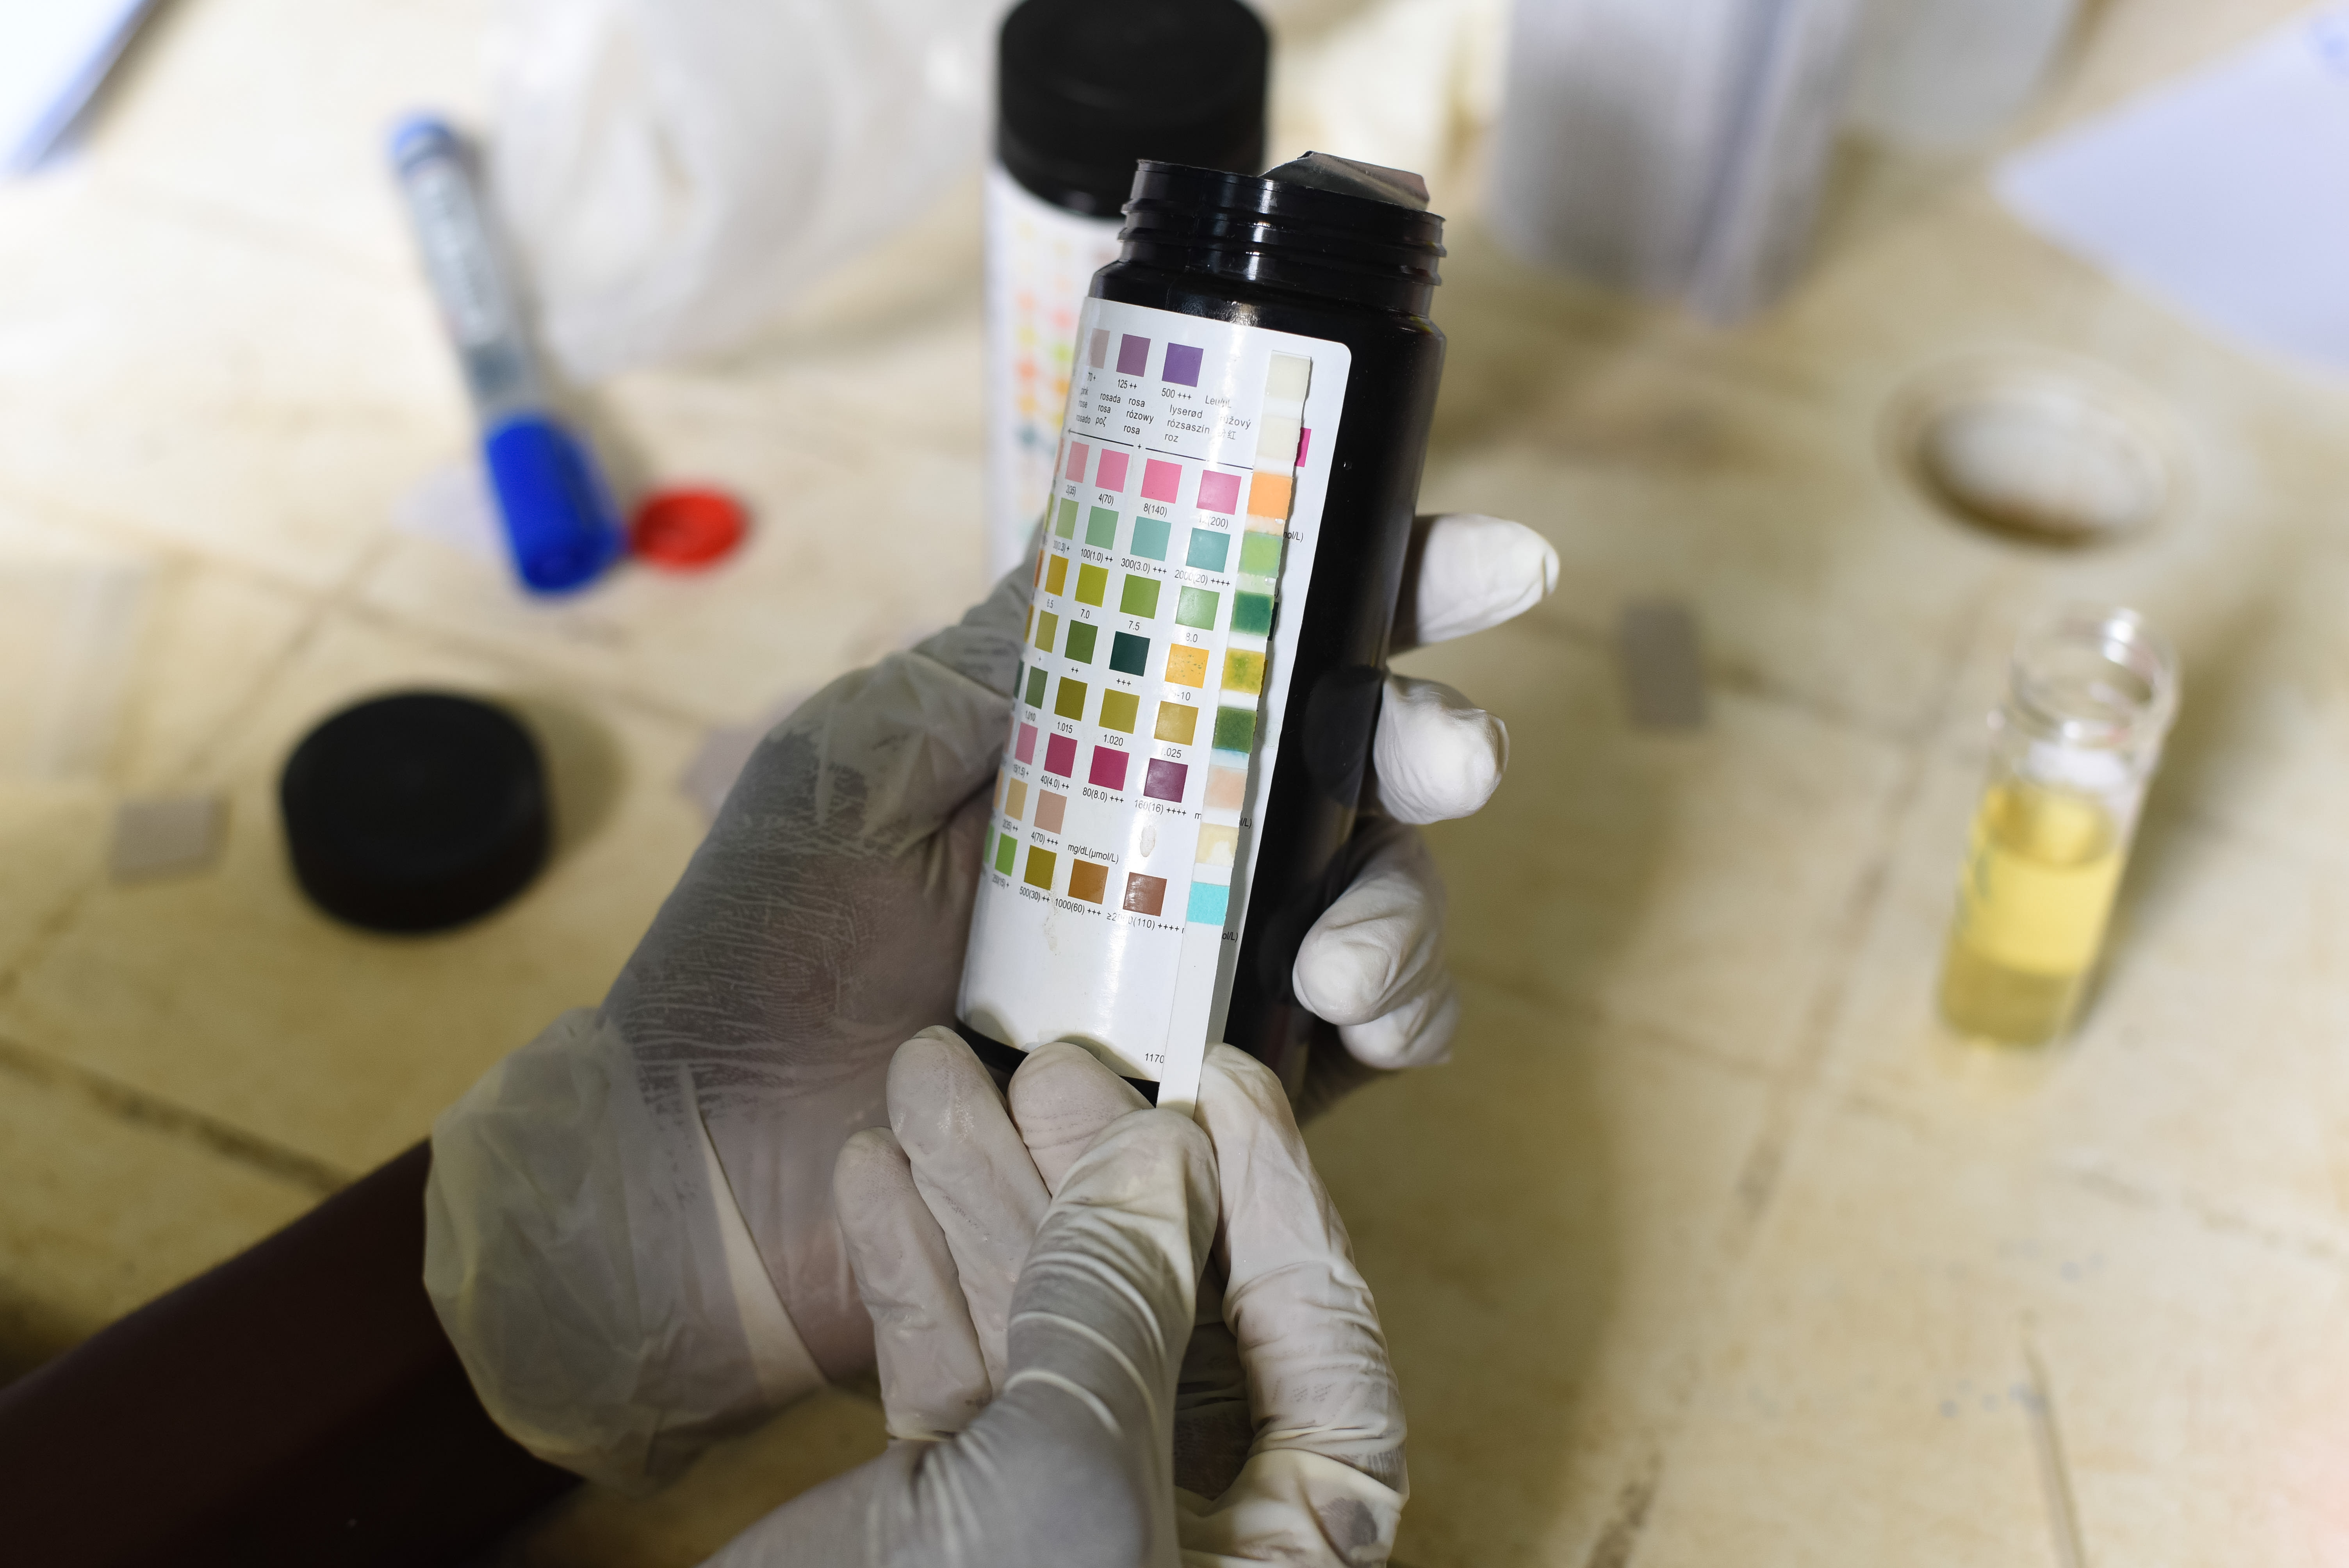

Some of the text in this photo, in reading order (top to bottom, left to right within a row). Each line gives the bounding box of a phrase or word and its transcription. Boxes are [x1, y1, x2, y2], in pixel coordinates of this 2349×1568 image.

[1117, 379, 1128, 389] 125
[1162, 388, 1175, 398] 500
[1076, 414, 1091, 424] rosado
[1098, 404, 1111, 414] rosa
[1126, 410, 1154, 424] rózowy
[1167, 419, 1210, 435] rózsaszín
[1100, 393, 1121, 404] rosada
[1128, 397, 1145, 408] rosa
[1169, 404, 1203, 419] lyserød
[1219, 416, 1251, 430] žový
[1123, 424, 1178, 443] rosa roz
[1098, 494, 1114, 506] 4(70)
[1144, 503, 1167, 518] 8(140)
[1081, 548, 1103, 563] 100(1.0)
[1121, 558, 1150, 574] 300(3.0)
[1174, 570, 1208, 585] 2000(20)
[1080, 609, 1090, 619] 7.0
[1128, 620, 1140, 631] 7.5
[1186, 633, 1198, 643] 8.0
[1172, 691, 1191, 701] -10
[1057, 722, 1073, 734] 1.015
[1103, 734, 1123, 747] 1.020
[1040, 775, 1060, 791] 40(4.0)
[1082, 788, 1107, 803] 80(8.0)
[1135, 800, 1163, 815] 160(16)
[1031, 832, 1045, 845] 4(70)
[1019, 886, 1040, 903] 500(30)
[1055, 898, 1085, 916] 1000(60)
[1107, 912, 1155, 931] ≥20(110)
[1145, 1053, 1164, 1064] 1170
